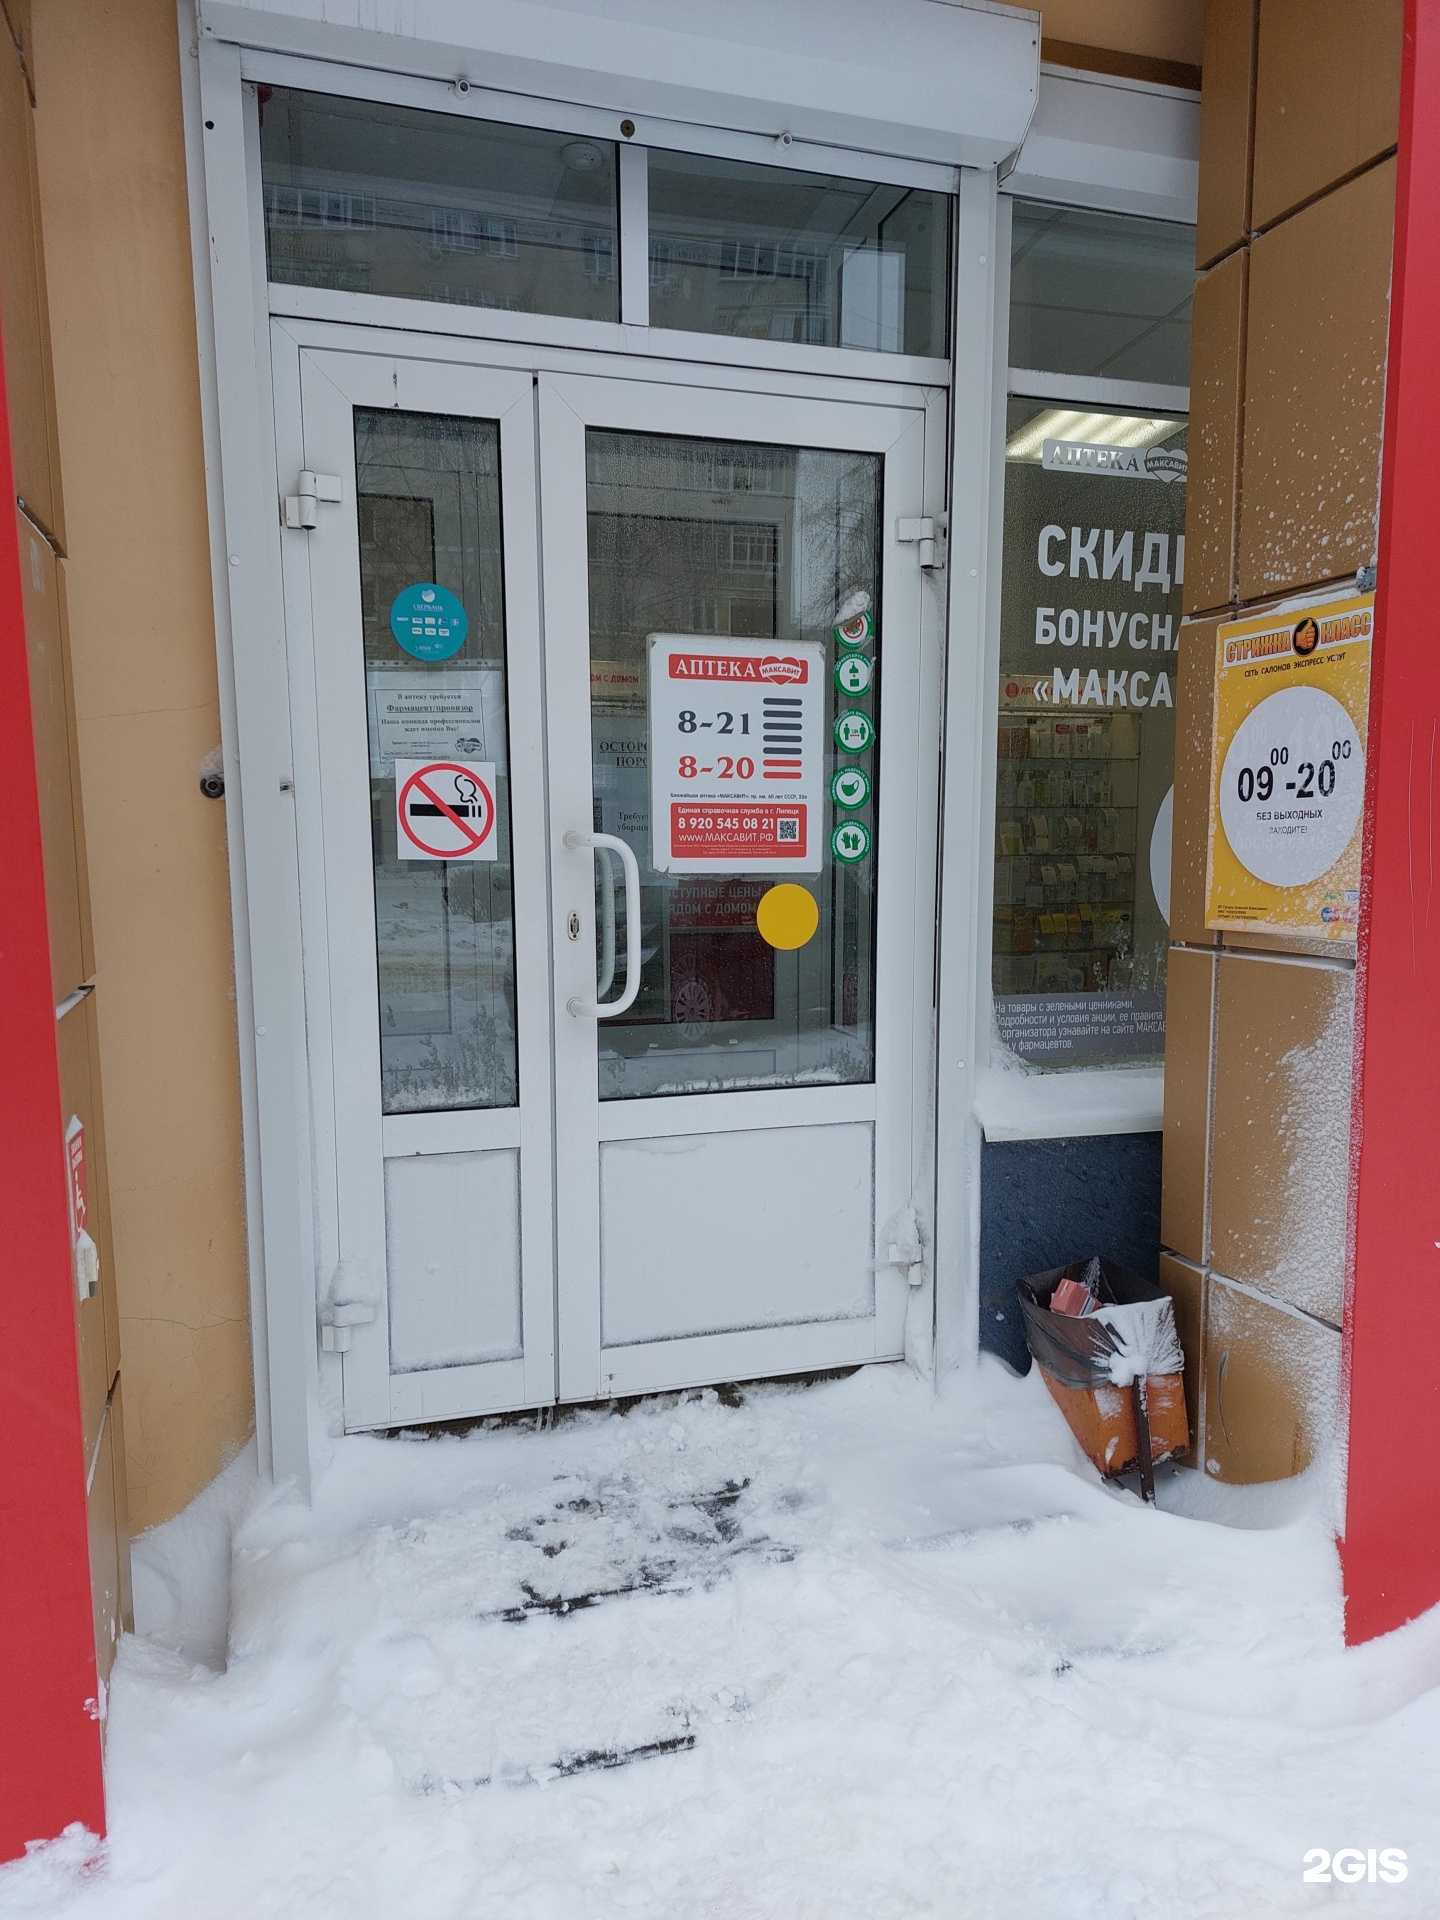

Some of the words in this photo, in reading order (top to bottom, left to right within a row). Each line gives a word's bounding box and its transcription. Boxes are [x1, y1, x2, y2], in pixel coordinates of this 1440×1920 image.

[1050, 445, 1139, 472] АПТЕКА
[1225, 631, 1291, 663] СТРИЖКА
[1320, 612, 1372, 644] КЛАСС
[675, 658, 756, 678] АПТЕКА
[761, 664, 800, 676] МАКСАВИТ
[1261, 663, 1291, 675] САЛОНОВ
[1293, 656, 1325, 670] ЭКСПРЕСС
[1033, 667, 1174, 708] «МАКСА
[677, 709, 751, 735] 8-21
[677, 755, 755, 780] 8-20
[678, 817, 686, 829] 8
[690, 817, 713, 829] 920
[716, 817, 739, 829] 545
[743, 818, 758, 829] 08
[761, 818, 774, 829] 21
[1256, 812, 1272, 821] БЕЗ
[1274, 809, 1323, 821] ВЫХОДНЫХ
[678, 832, 774, 843] www.МАКСАВИТ.РФ
[1008, 1003, 1037, 1014] товары
[1046, 1001, 1087, 1012] зелеными
[1056, 1013, 1090, 1026] условия
[1120, 1012, 1129, 1021] ее
[1001, 1027, 1057, 1041] организатора
[1058, 1024, 1099, 1039] узнавайте
[1101, 1025, 1110, 1034] на
[1112, 1022, 1135, 1034] сайте
[1019, 1040, 1074, 1053] фармацевтов.
